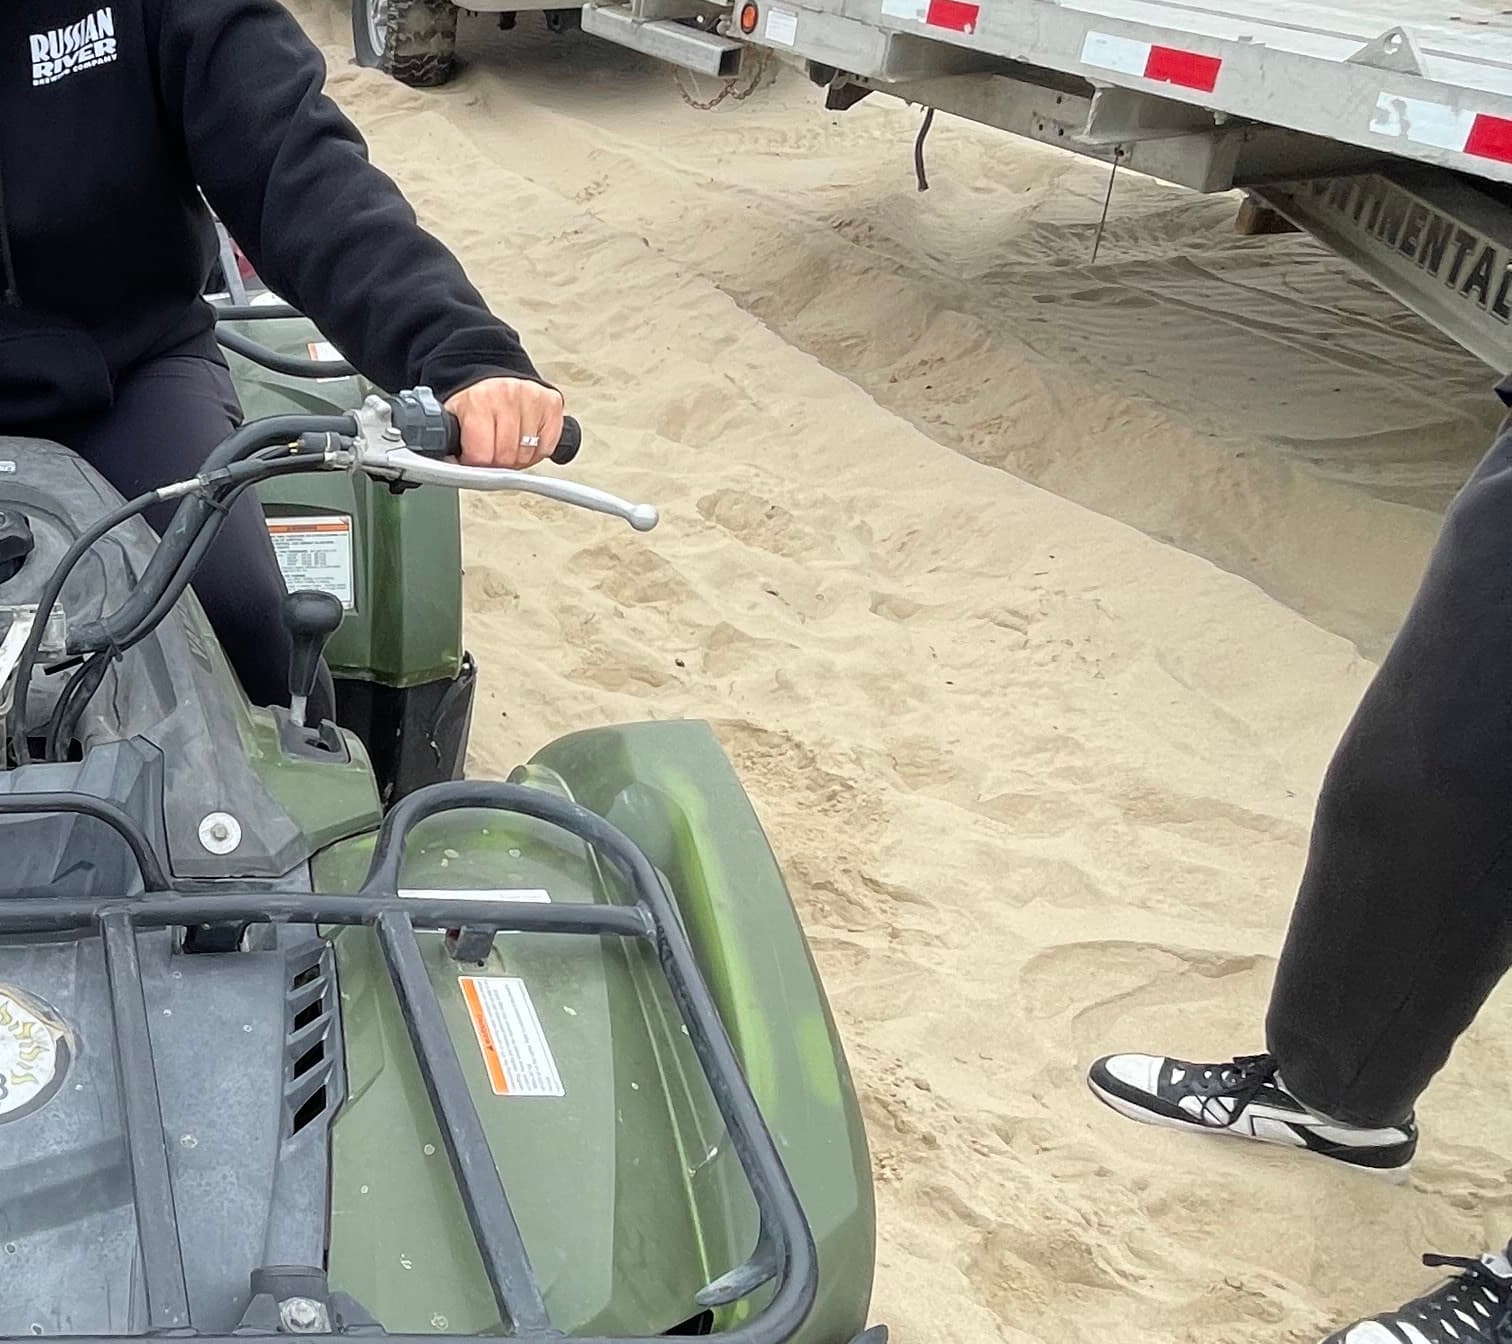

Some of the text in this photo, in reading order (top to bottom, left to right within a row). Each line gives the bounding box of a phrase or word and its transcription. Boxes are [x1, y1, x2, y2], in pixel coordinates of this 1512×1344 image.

[29, 6, 115, 63] RUSSIAN
[32, 38, 117, 79] RIVER
[72, 53, 118, 73] COMPANY
